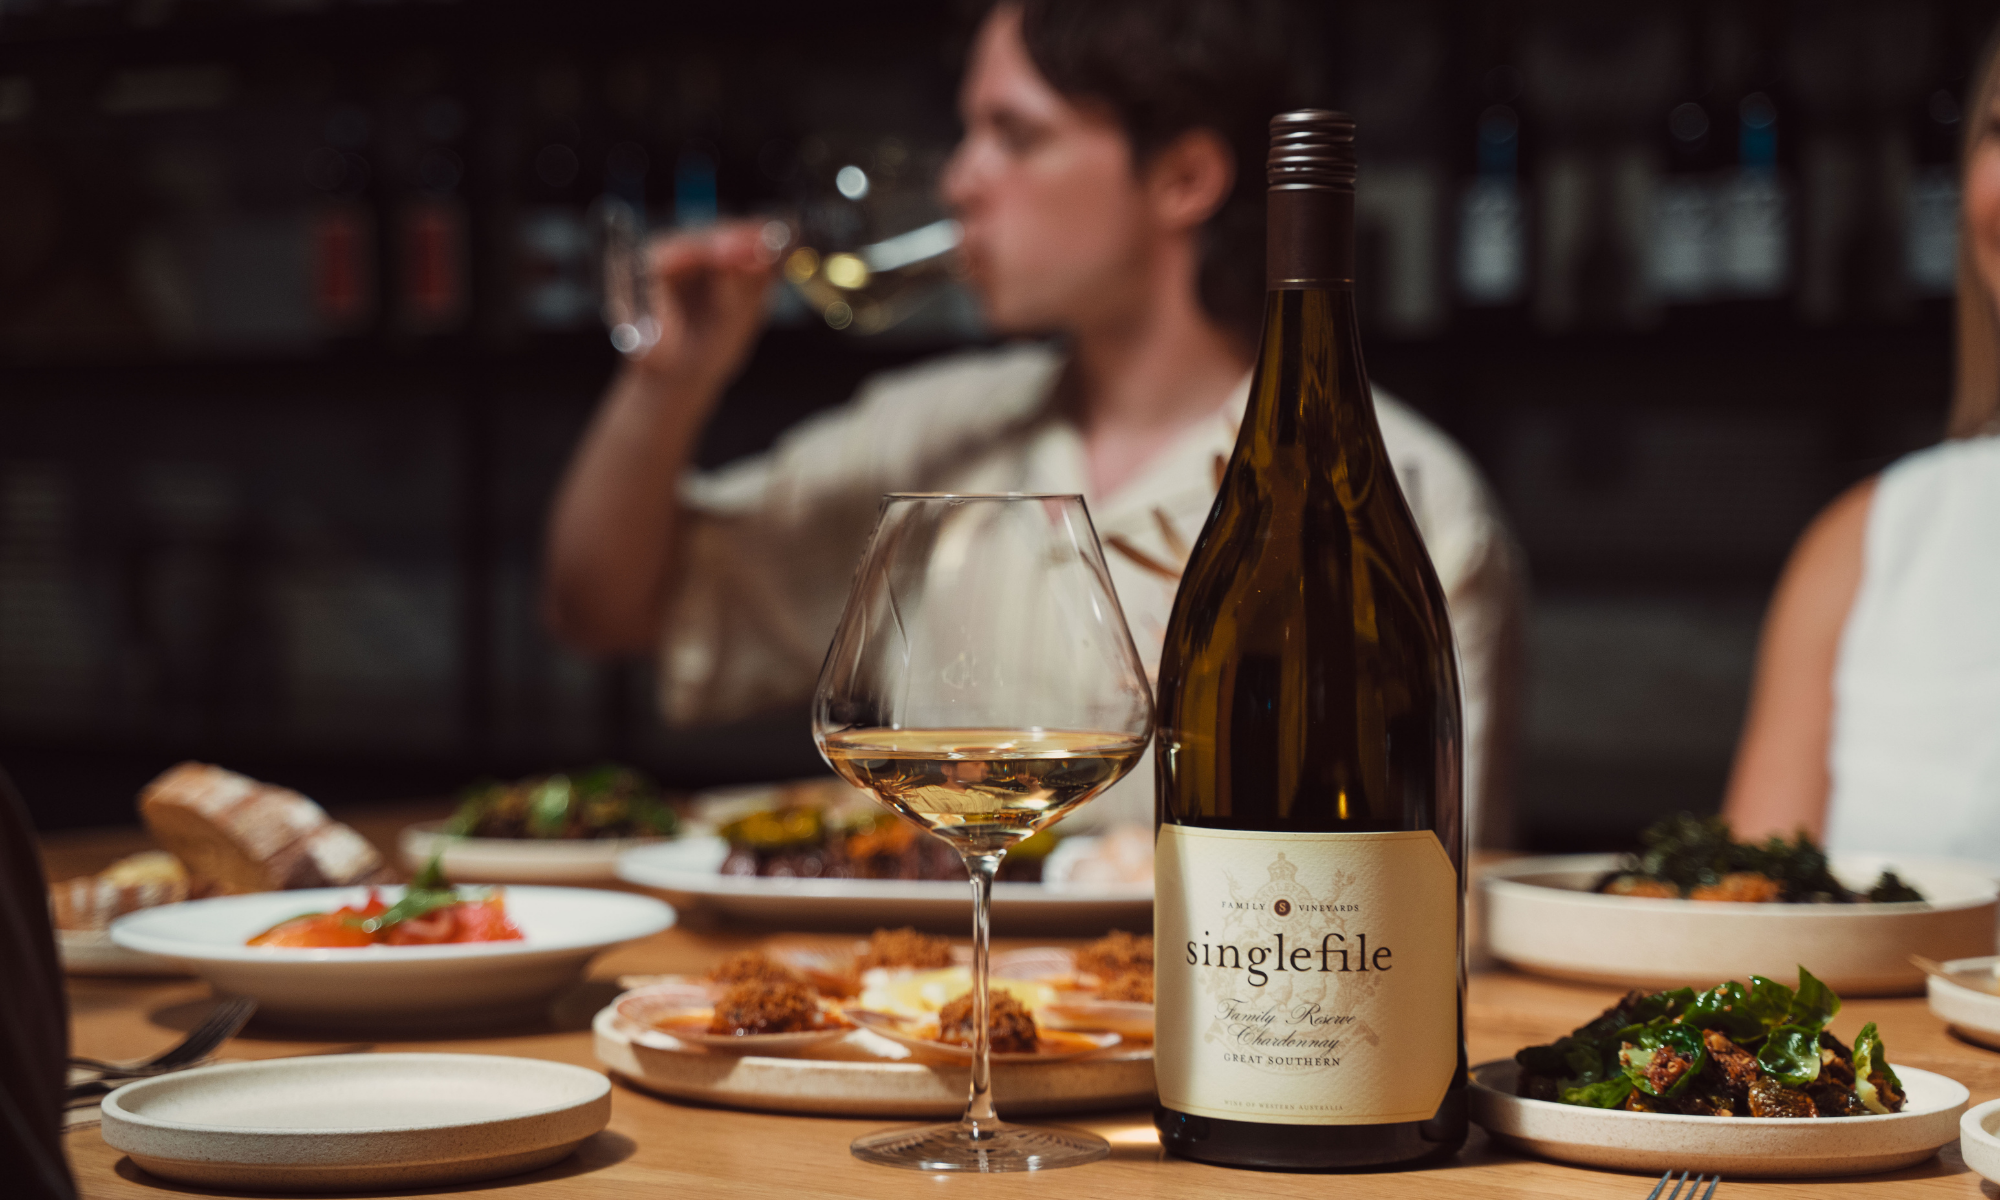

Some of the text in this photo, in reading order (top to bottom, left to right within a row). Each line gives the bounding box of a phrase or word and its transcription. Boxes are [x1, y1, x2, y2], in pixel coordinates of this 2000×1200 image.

[1221, 901, 1266, 911] FAMILY
[1298, 904, 1359, 912] VINEYARDS
[1186, 931, 1393, 987] singlefile
[1214, 998, 1357, 1032] Family Reserve
[1227, 1022, 1340, 1058] Chardonnay
[1223, 1053, 1341, 1066] GREAT SOUTHERN
[1259, 1102, 1295, 1110] WESTERN
